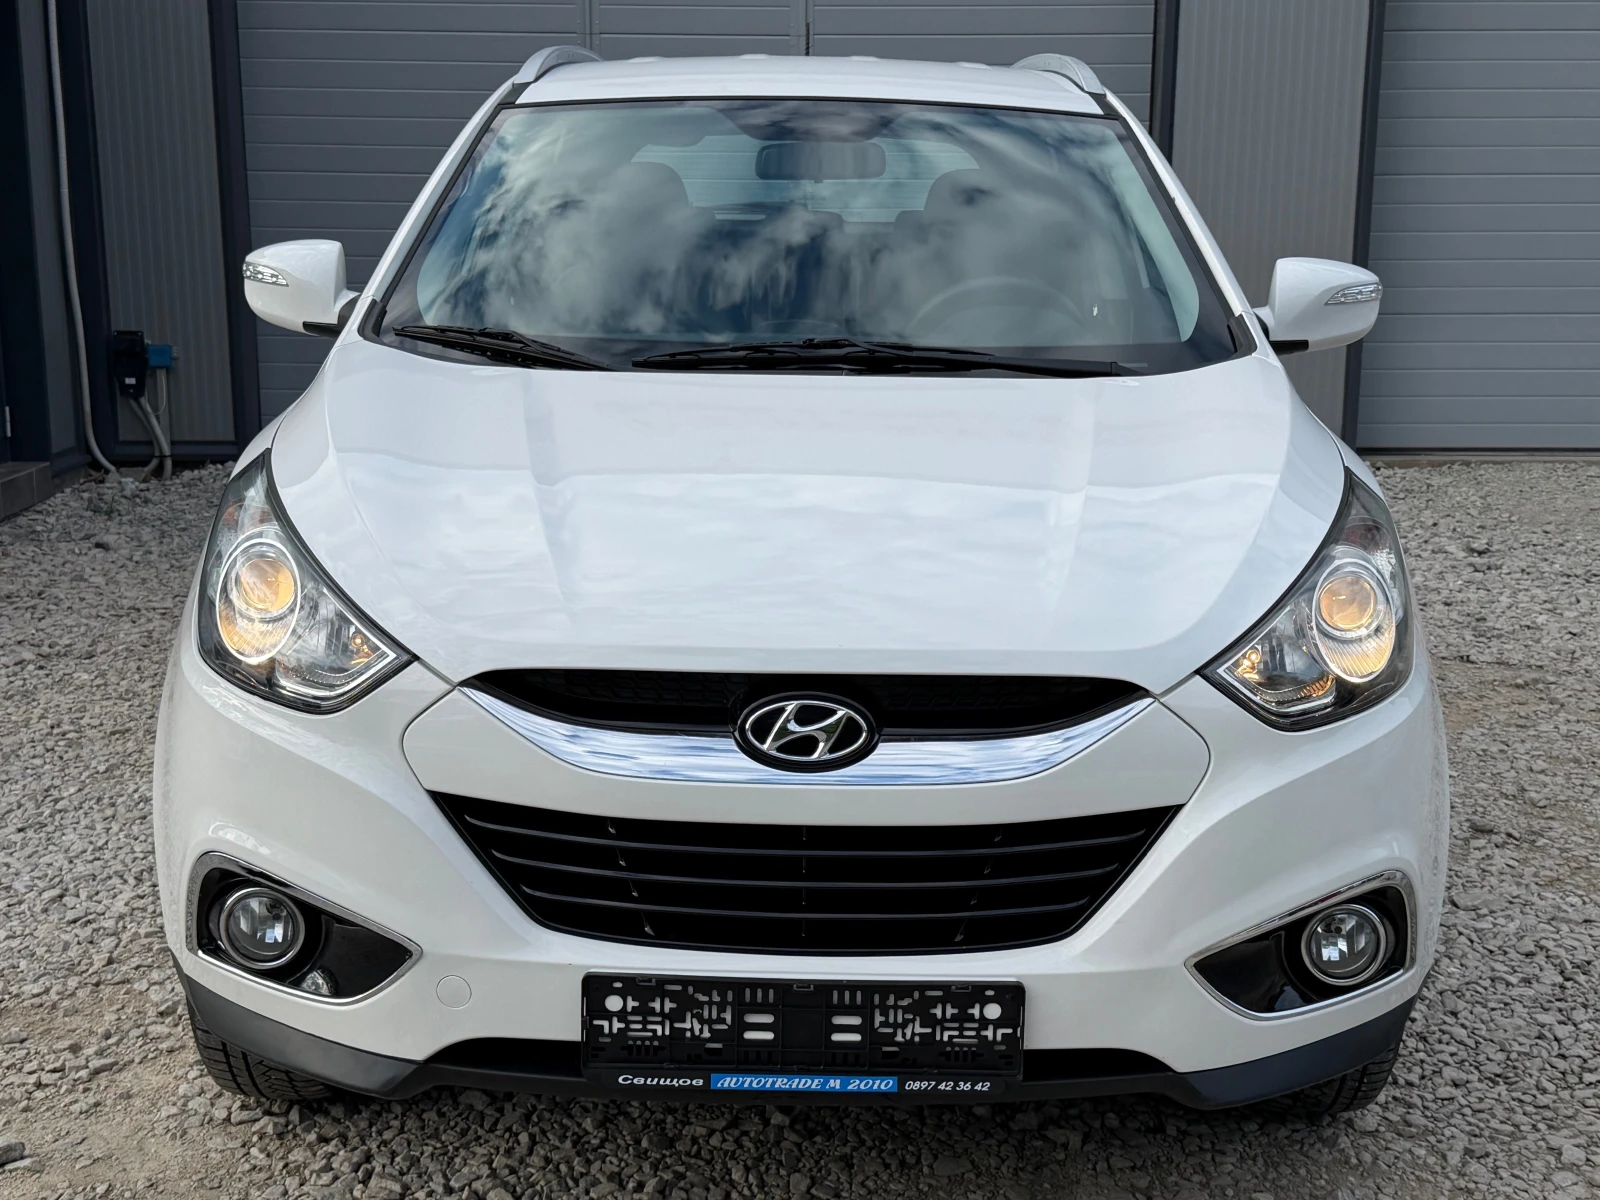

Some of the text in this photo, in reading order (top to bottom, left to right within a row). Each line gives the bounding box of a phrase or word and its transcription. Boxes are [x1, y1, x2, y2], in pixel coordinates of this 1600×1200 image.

[618, 1074, 704, 1087] Свищов
[717, 1076, 894, 1090] AUTOTRADE M 2010
[905, 1081, 991, 1092] 0897 42 36 42
